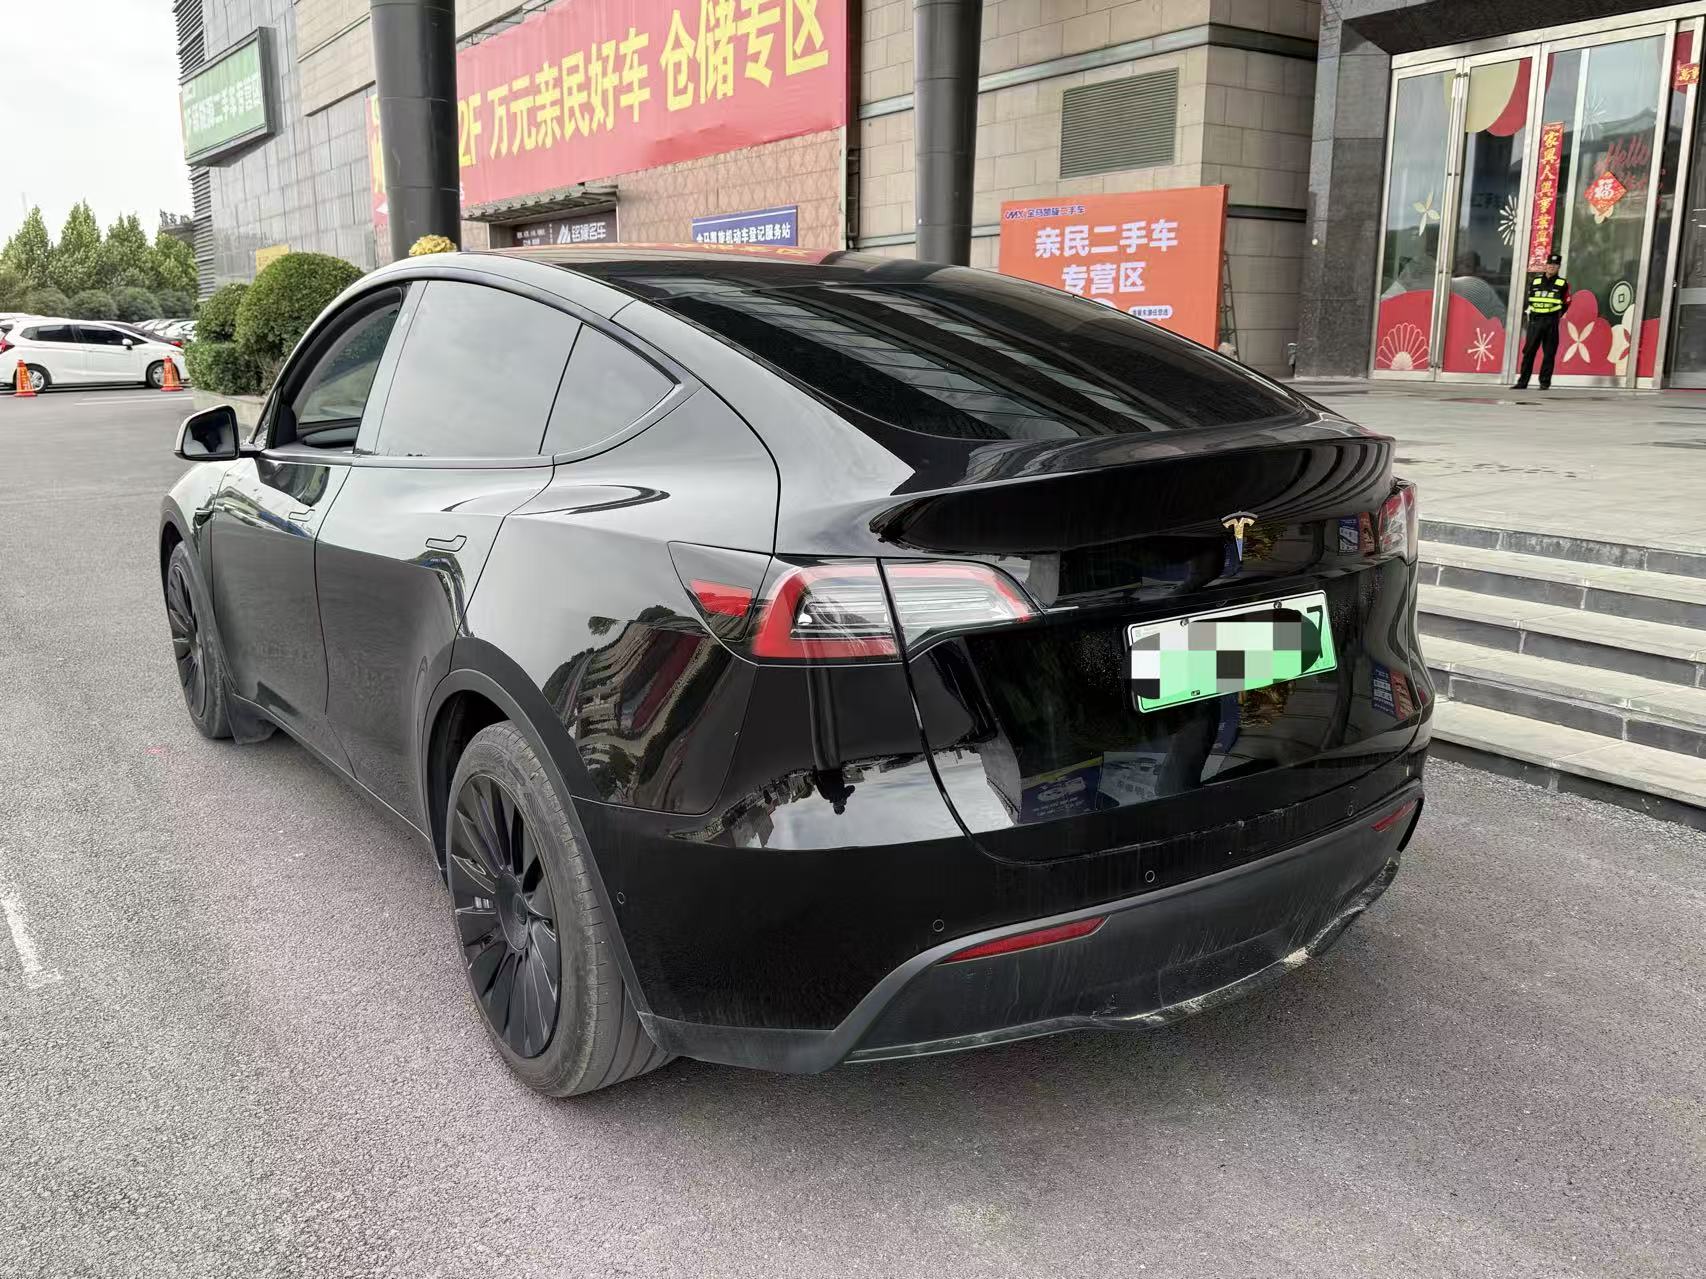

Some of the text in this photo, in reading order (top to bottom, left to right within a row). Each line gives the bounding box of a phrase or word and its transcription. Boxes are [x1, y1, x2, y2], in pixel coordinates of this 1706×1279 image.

[458, 92, 482, 167] 2F
[487, 27, 651, 161] 万元亲民好车
[660, 0, 829, 112] 仓储专区
[1035, 218, 1179, 258] 亲民二手车
[1061, 261, 1147, 296] 专营区
